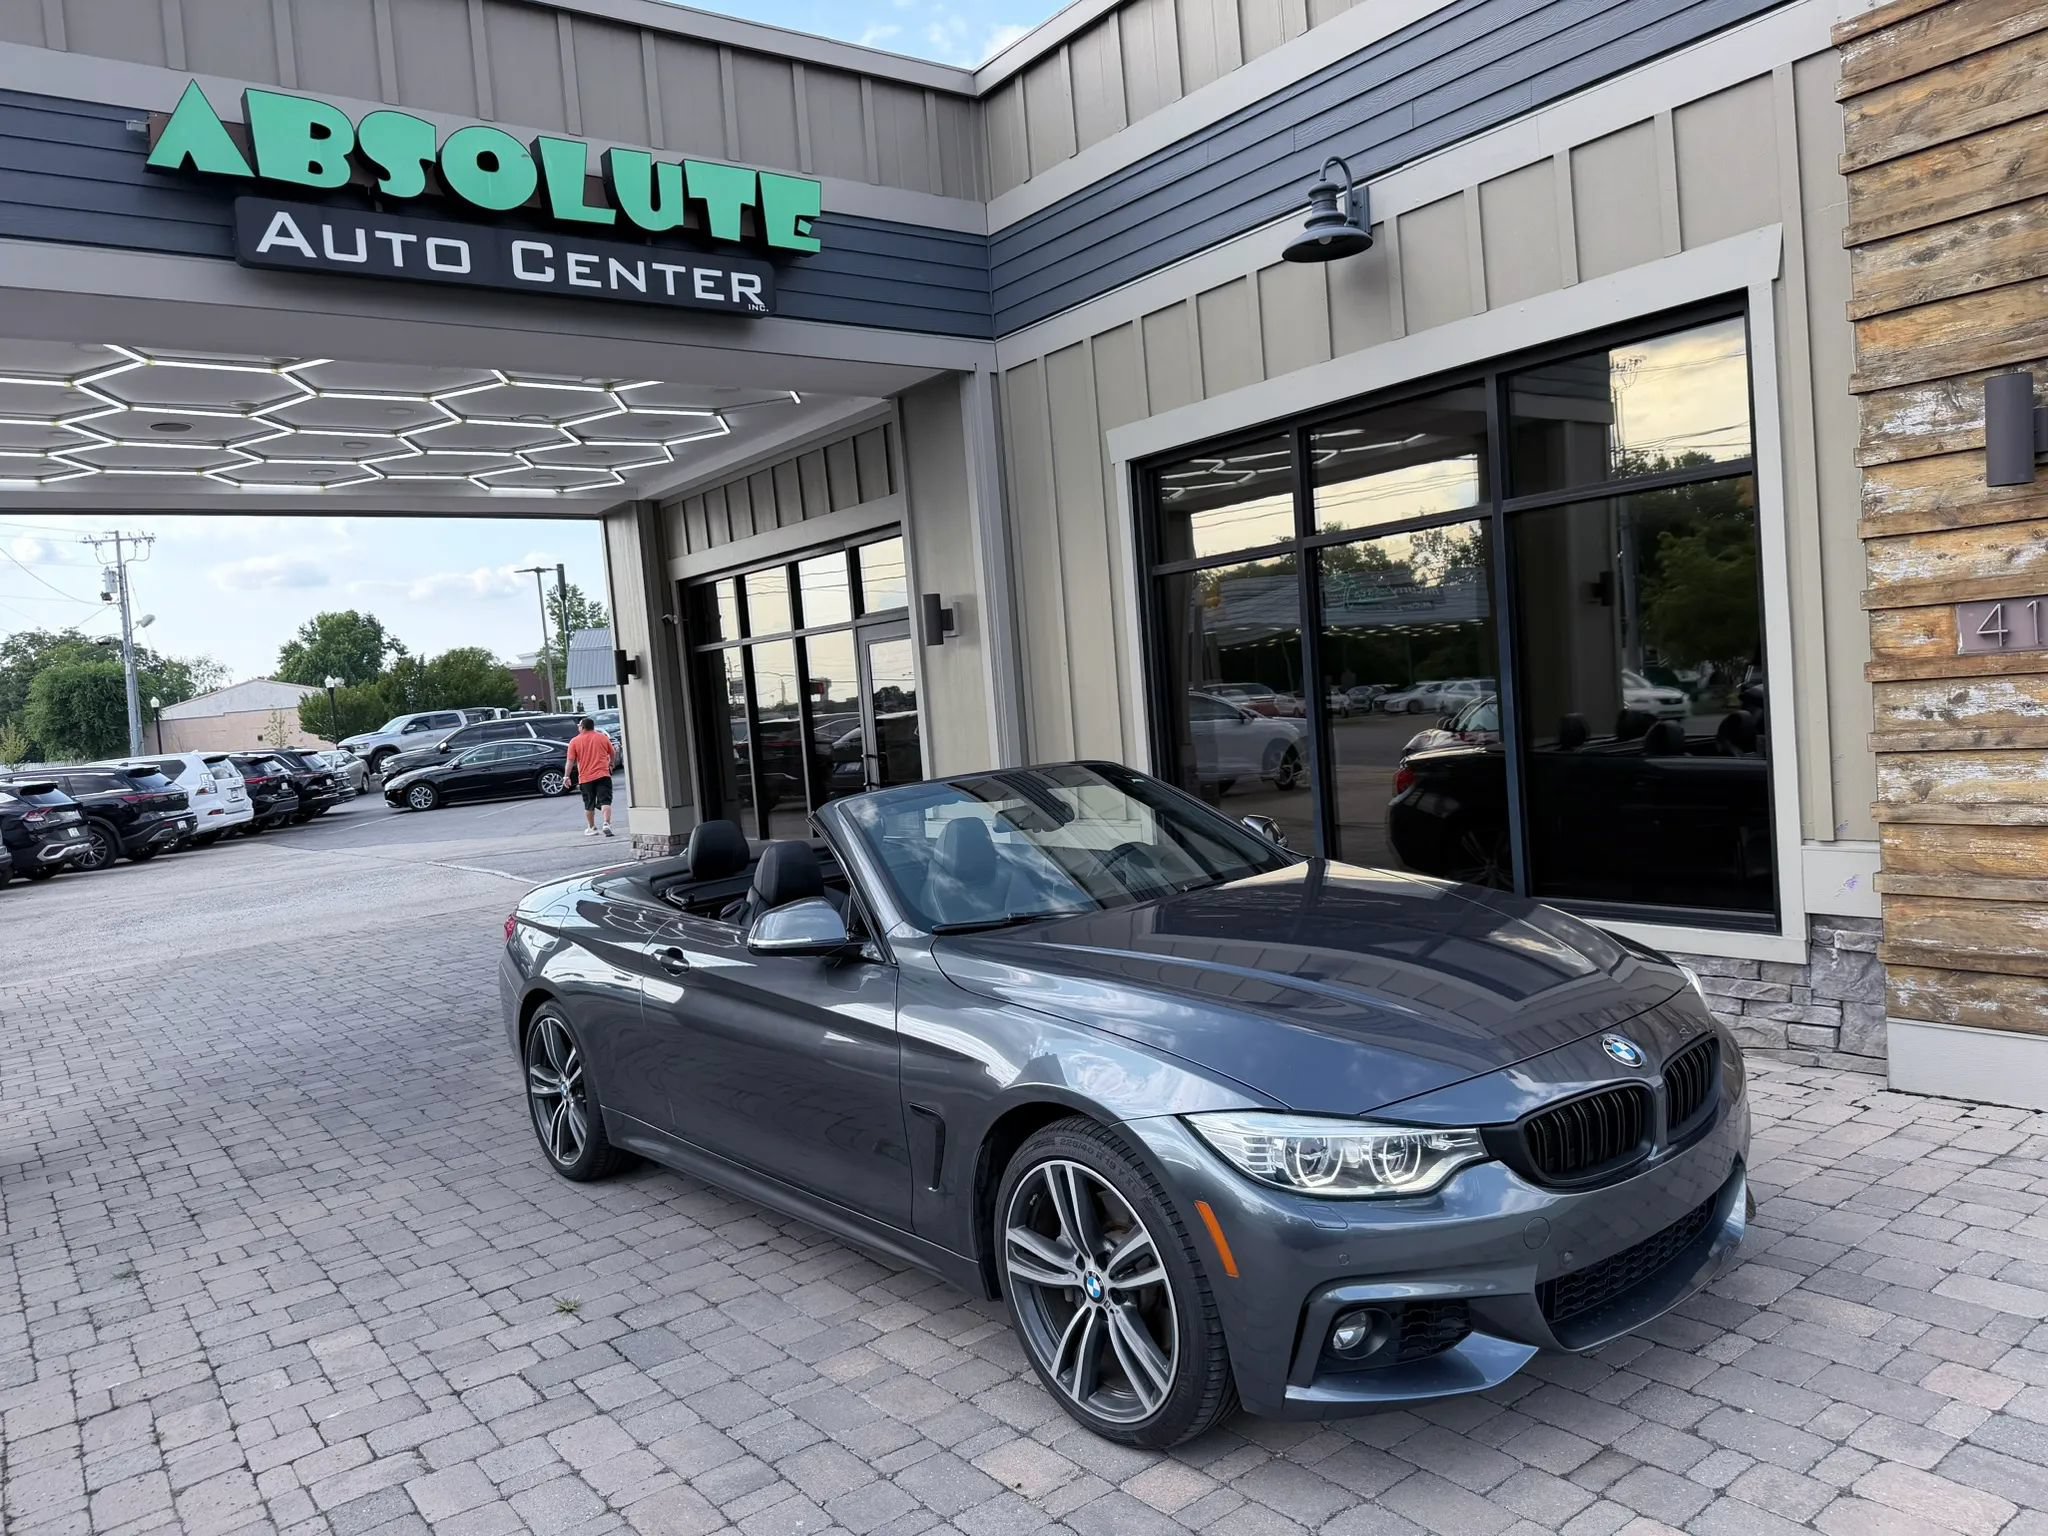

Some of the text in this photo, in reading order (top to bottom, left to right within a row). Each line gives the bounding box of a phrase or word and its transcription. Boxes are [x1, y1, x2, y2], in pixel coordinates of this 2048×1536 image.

[146, 79, 822, 253] ABSOLUTE
[256, 211, 766, 305] AUTO CENTER
[748, 303, 769, 312] INC.
[1976, 600, 2039, 647] 41
